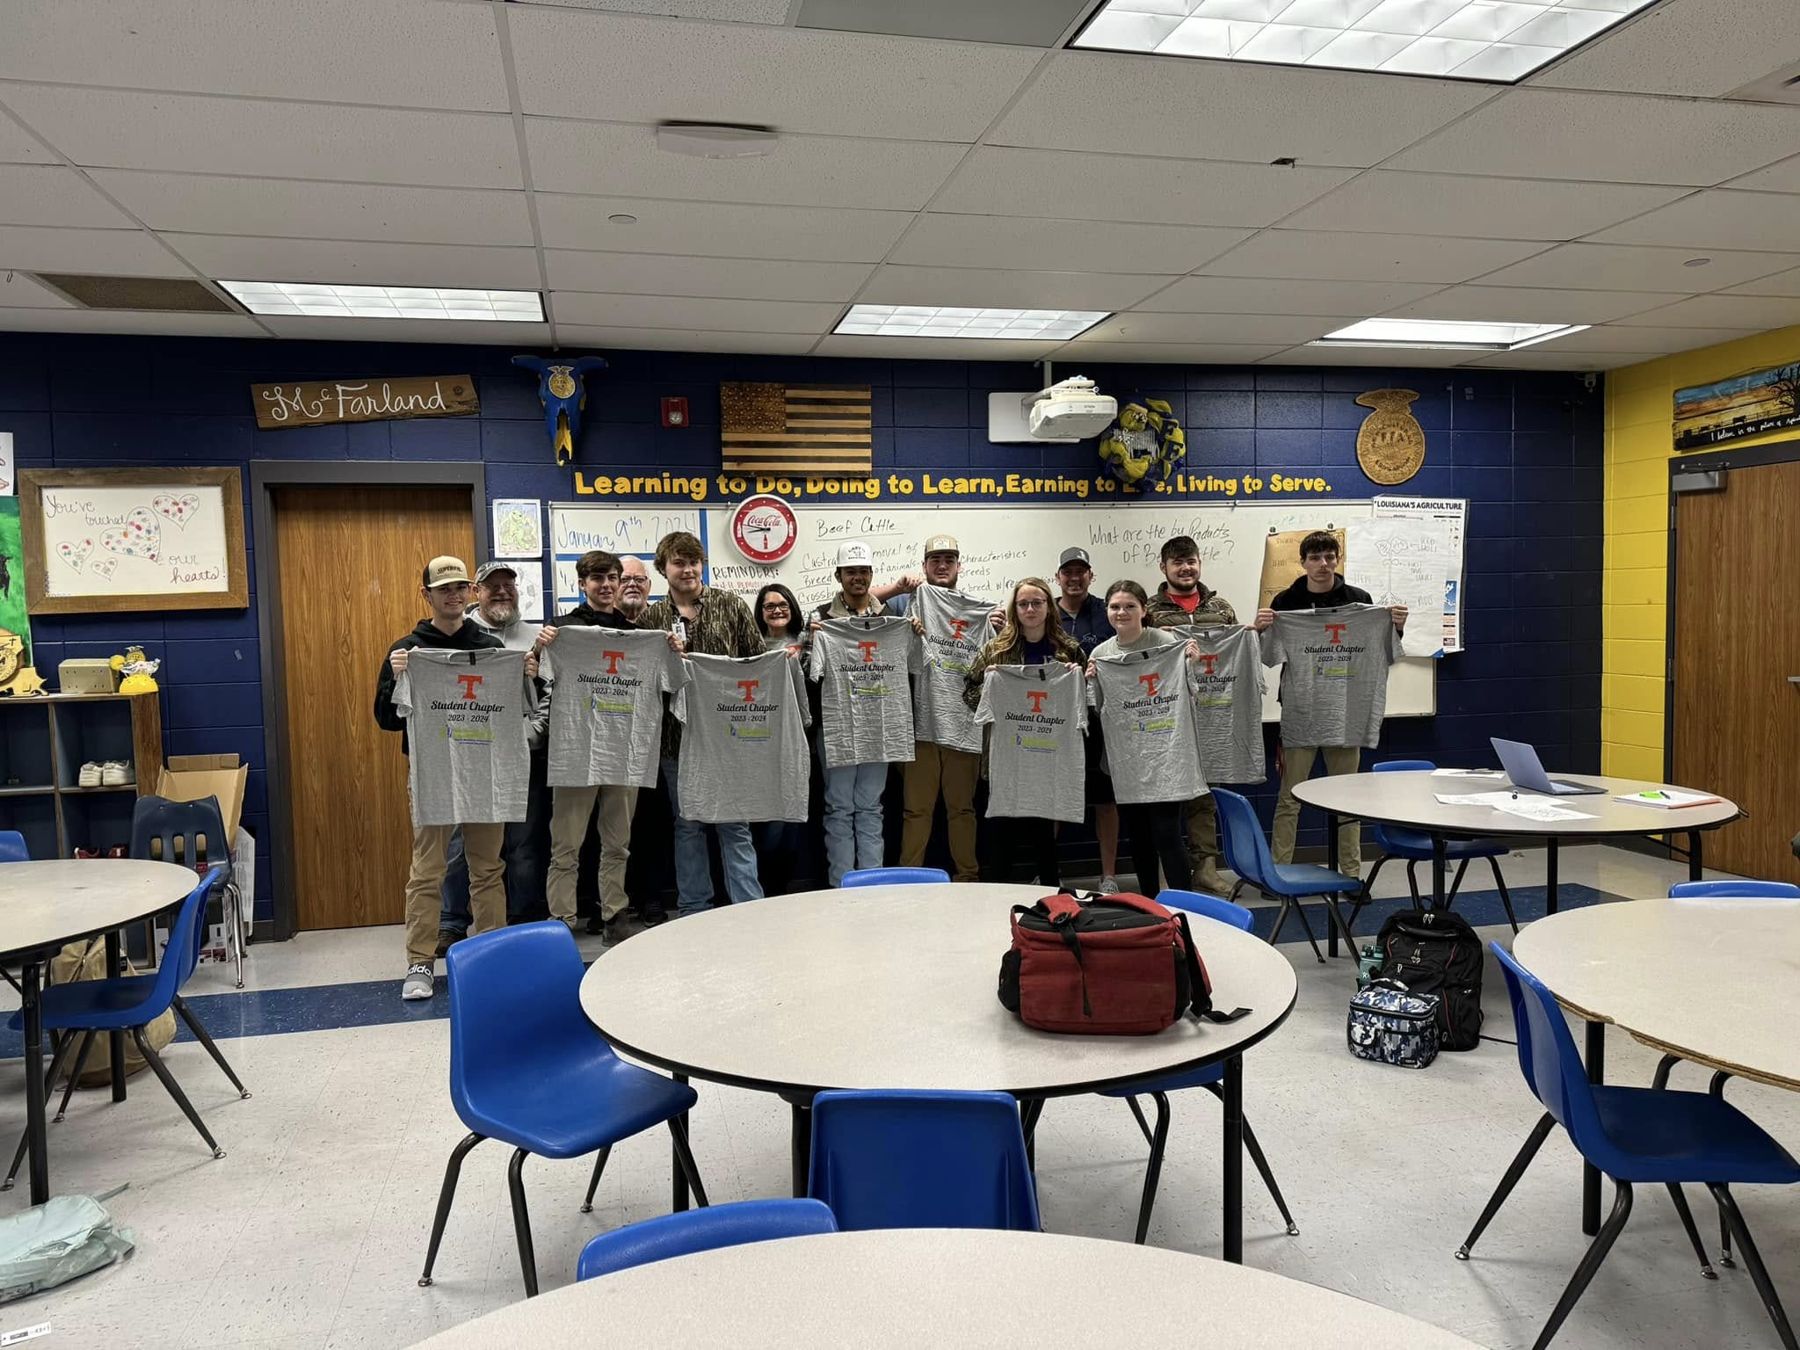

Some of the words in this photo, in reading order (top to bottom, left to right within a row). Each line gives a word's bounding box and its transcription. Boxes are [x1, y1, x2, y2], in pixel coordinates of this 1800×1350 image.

[574, 471, 708, 501] Learning
[716, 475, 748, 495] to
[755, 476, 802, 498] Do,
[806, 476, 881, 499] Doing
[887, 474, 914, 494] to
[922, 473, 1004, 498] Learn,
[1006, 474, 1089, 498] Earning
[1095, 476, 1116, 492] to
[1177, 474, 1237, 496] Living
[1242, 475, 1263, 494] to
[1269, 473, 1332, 493] Serve.
[46, 494, 96, 518] You've
[1376, 500, 1415, 509] LOUISIANA'S
[1416, 502, 1463, 510] AGRICULTURE
[85, 514, 129, 526] touched
[817, 519, 853, 538] Beef
[860, 515, 896, 534] Cattle
[558, 513, 615, 551] January
[1089, 524, 1119, 546] What
[1122, 529, 1143, 541] are
[1146, 523, 1166, 540] the
[168, 555, 200, 566] our
[1123, 544, 1140, 564] of
[712, 566, 780, 580] REMINDERS:
[949, 618, 970, 640] T
[1325, 623, 1347, 643] T
[857, 641, 878, 662] T
[929, 634, 955, 647] Student
[956, 640, 978, 652] Chapte
[1304, 645, 1333, 653] Student
[1335, 645, 1366, 654] Chapter
[602, 650, 625, 674] T
[840, 664, 867, 672] Student
[1199, 654, 1218, 674] T
[457, 674, 484, 700] T
[577, 673, 611, 684] Student
[611, 675, 643, 688] Chapter
[1138, 672, 1160, 696] T
[737, 680, 759, 702] T
[430, 700, 467, 710] Student
[469, 701, 505, 714] Chapter
[716, 703, 748, 712] Student
[749, 703, 779, 714] Chapter
[1027, 690, 1049, 713] T
[1123, 699, 1151, 710] Student
[1005, 711, 1034, 721] Student
[1036, 714, 1066, 725] Chapter
